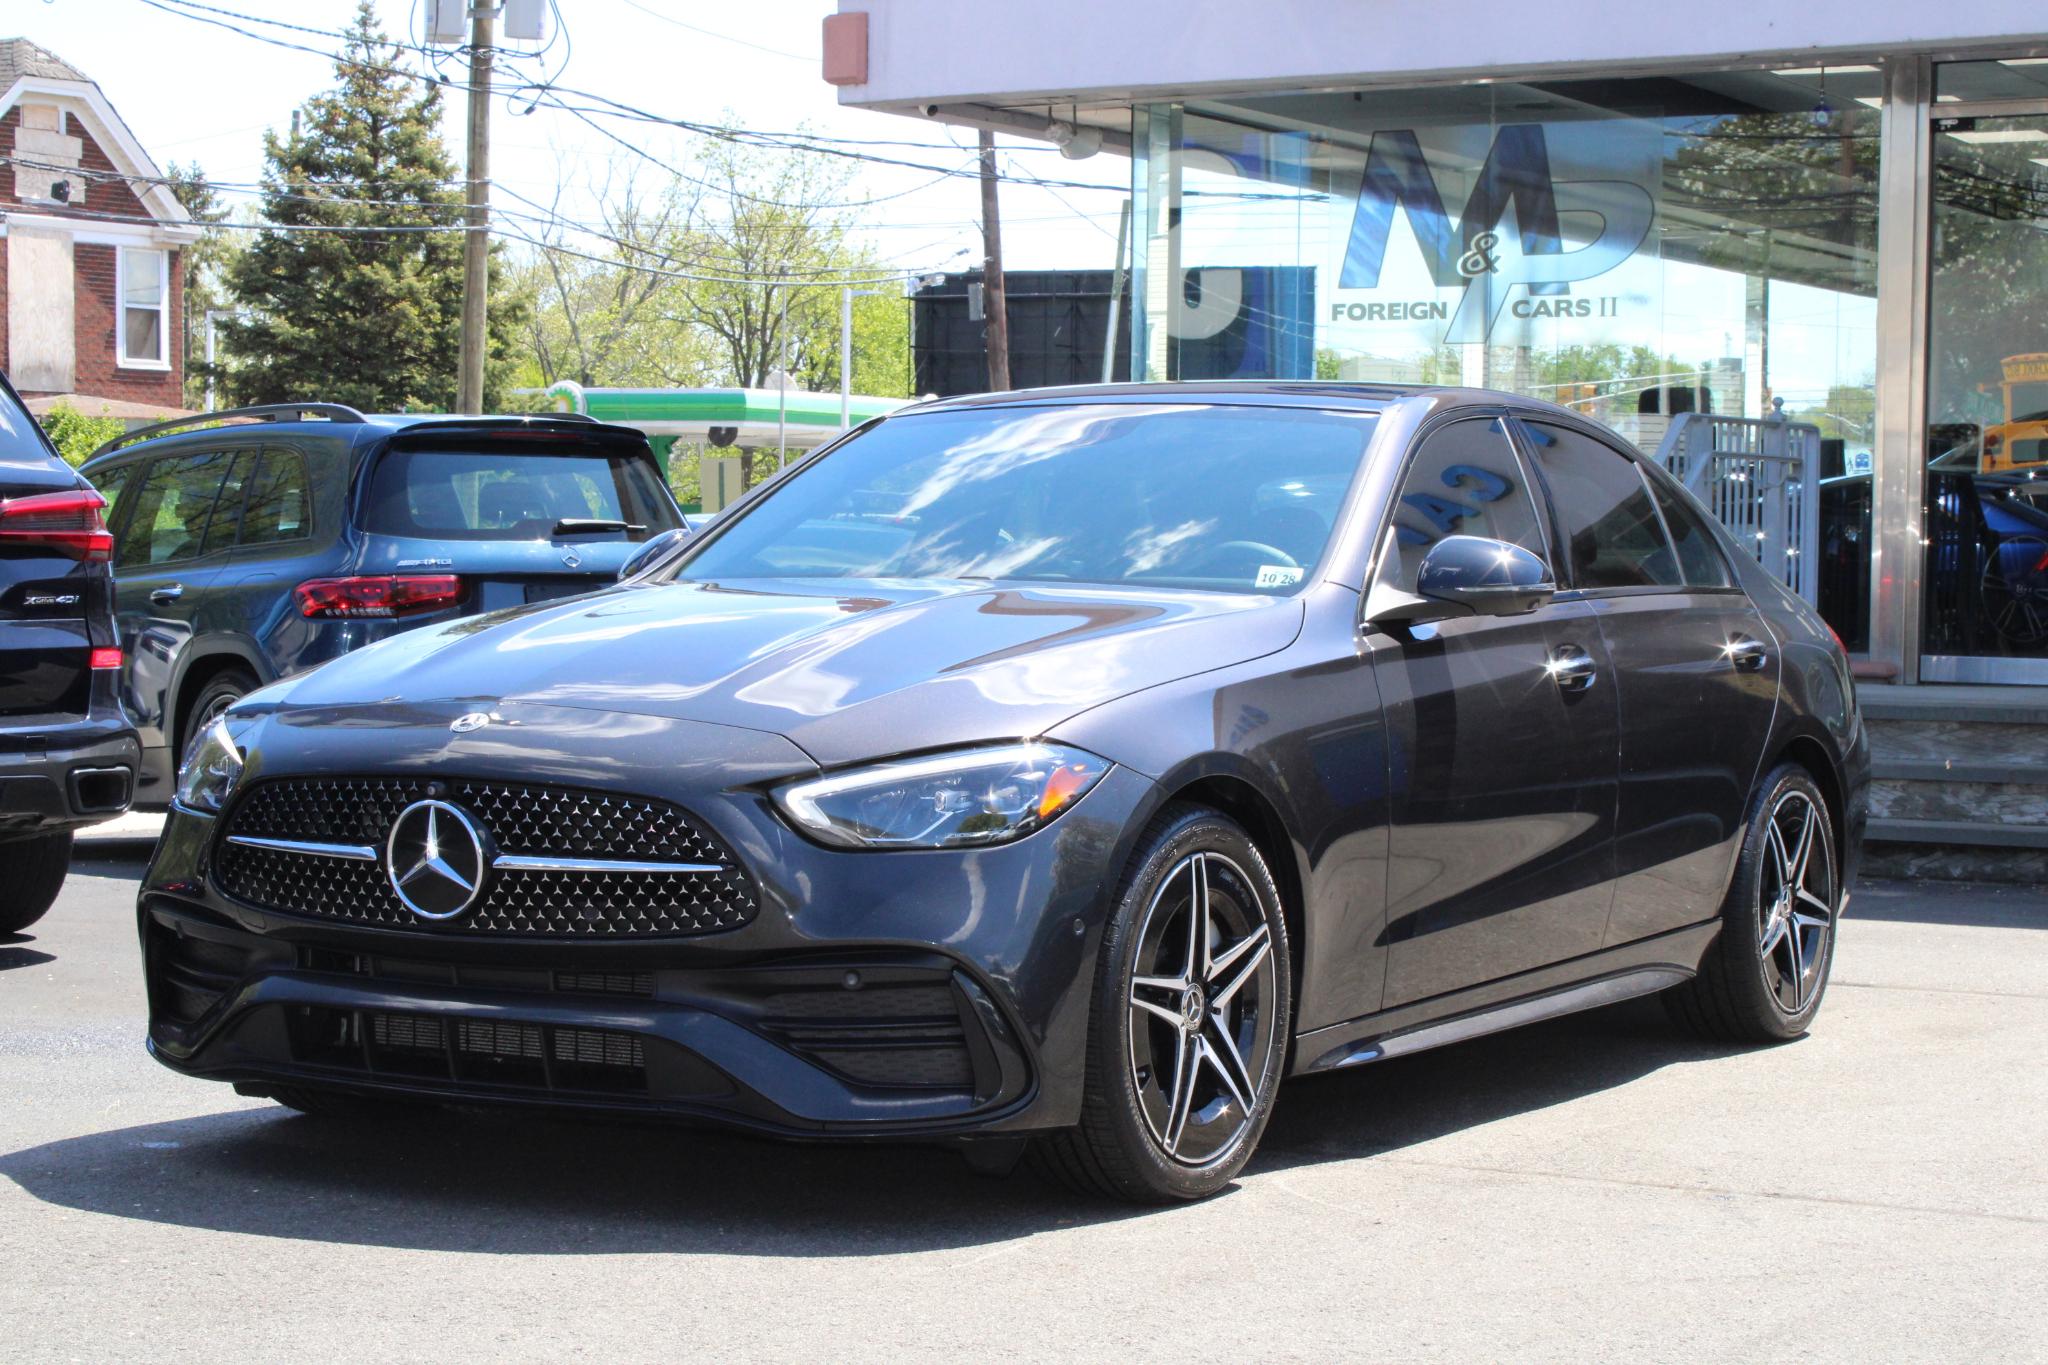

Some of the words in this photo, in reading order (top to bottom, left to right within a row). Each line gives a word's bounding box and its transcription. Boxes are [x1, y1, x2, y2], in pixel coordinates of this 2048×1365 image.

[1331, 301, 1447, 322] FOREIGN
[1511, 298, 1591, 319] CARS
[1599, 296, 1617, 317] II
[1261, 572, 1278, 584] 10
